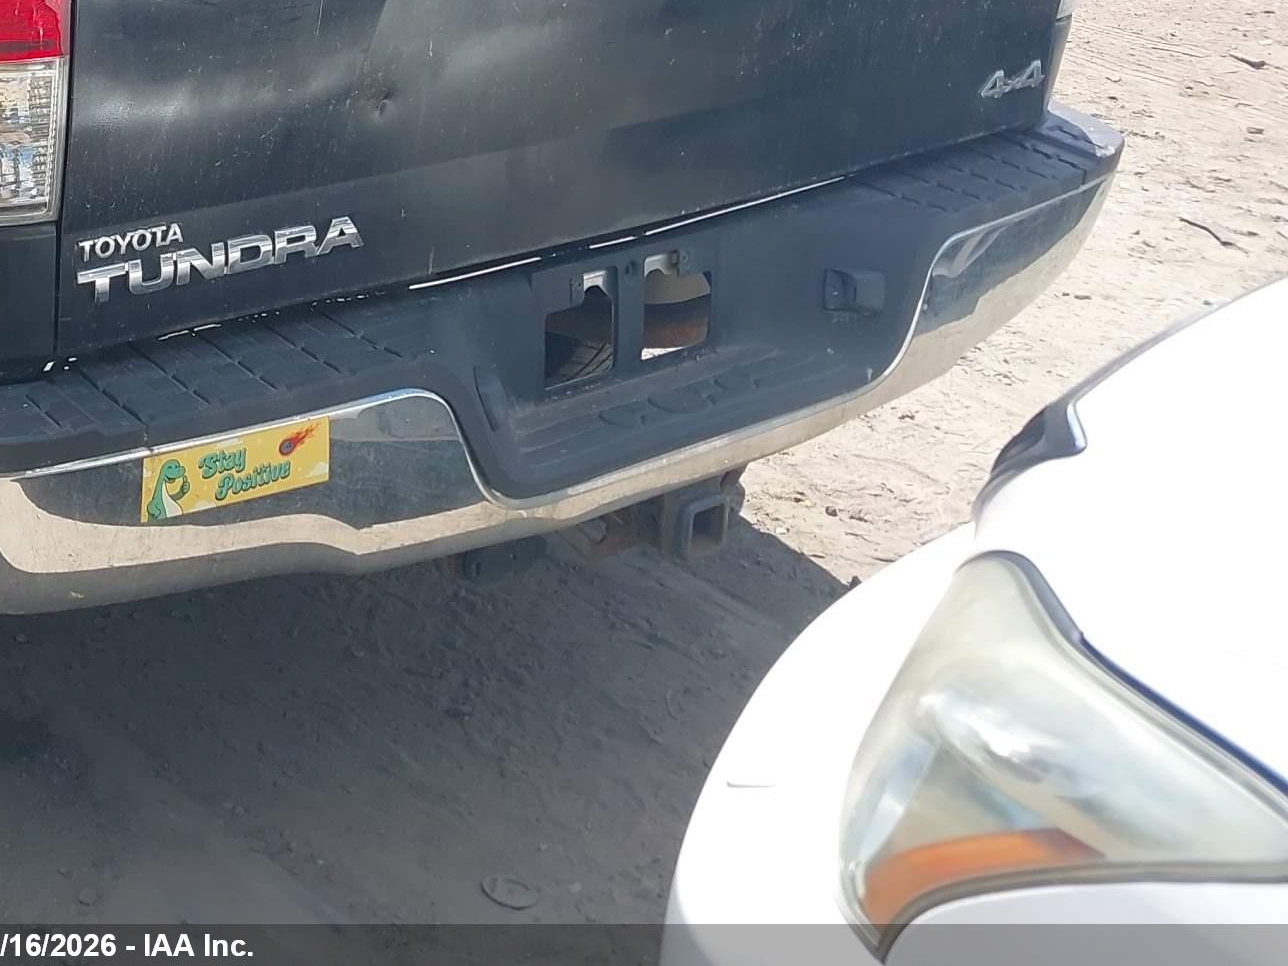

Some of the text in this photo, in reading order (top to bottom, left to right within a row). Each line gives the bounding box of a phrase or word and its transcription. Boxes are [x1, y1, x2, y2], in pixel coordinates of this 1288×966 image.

[76, 215, 365, 303] TUNDRA
[78, 222, 184, 263] TOYOTA
[198, 447, 247, 479] Stay
[215, 460, 291, 501] Positive
